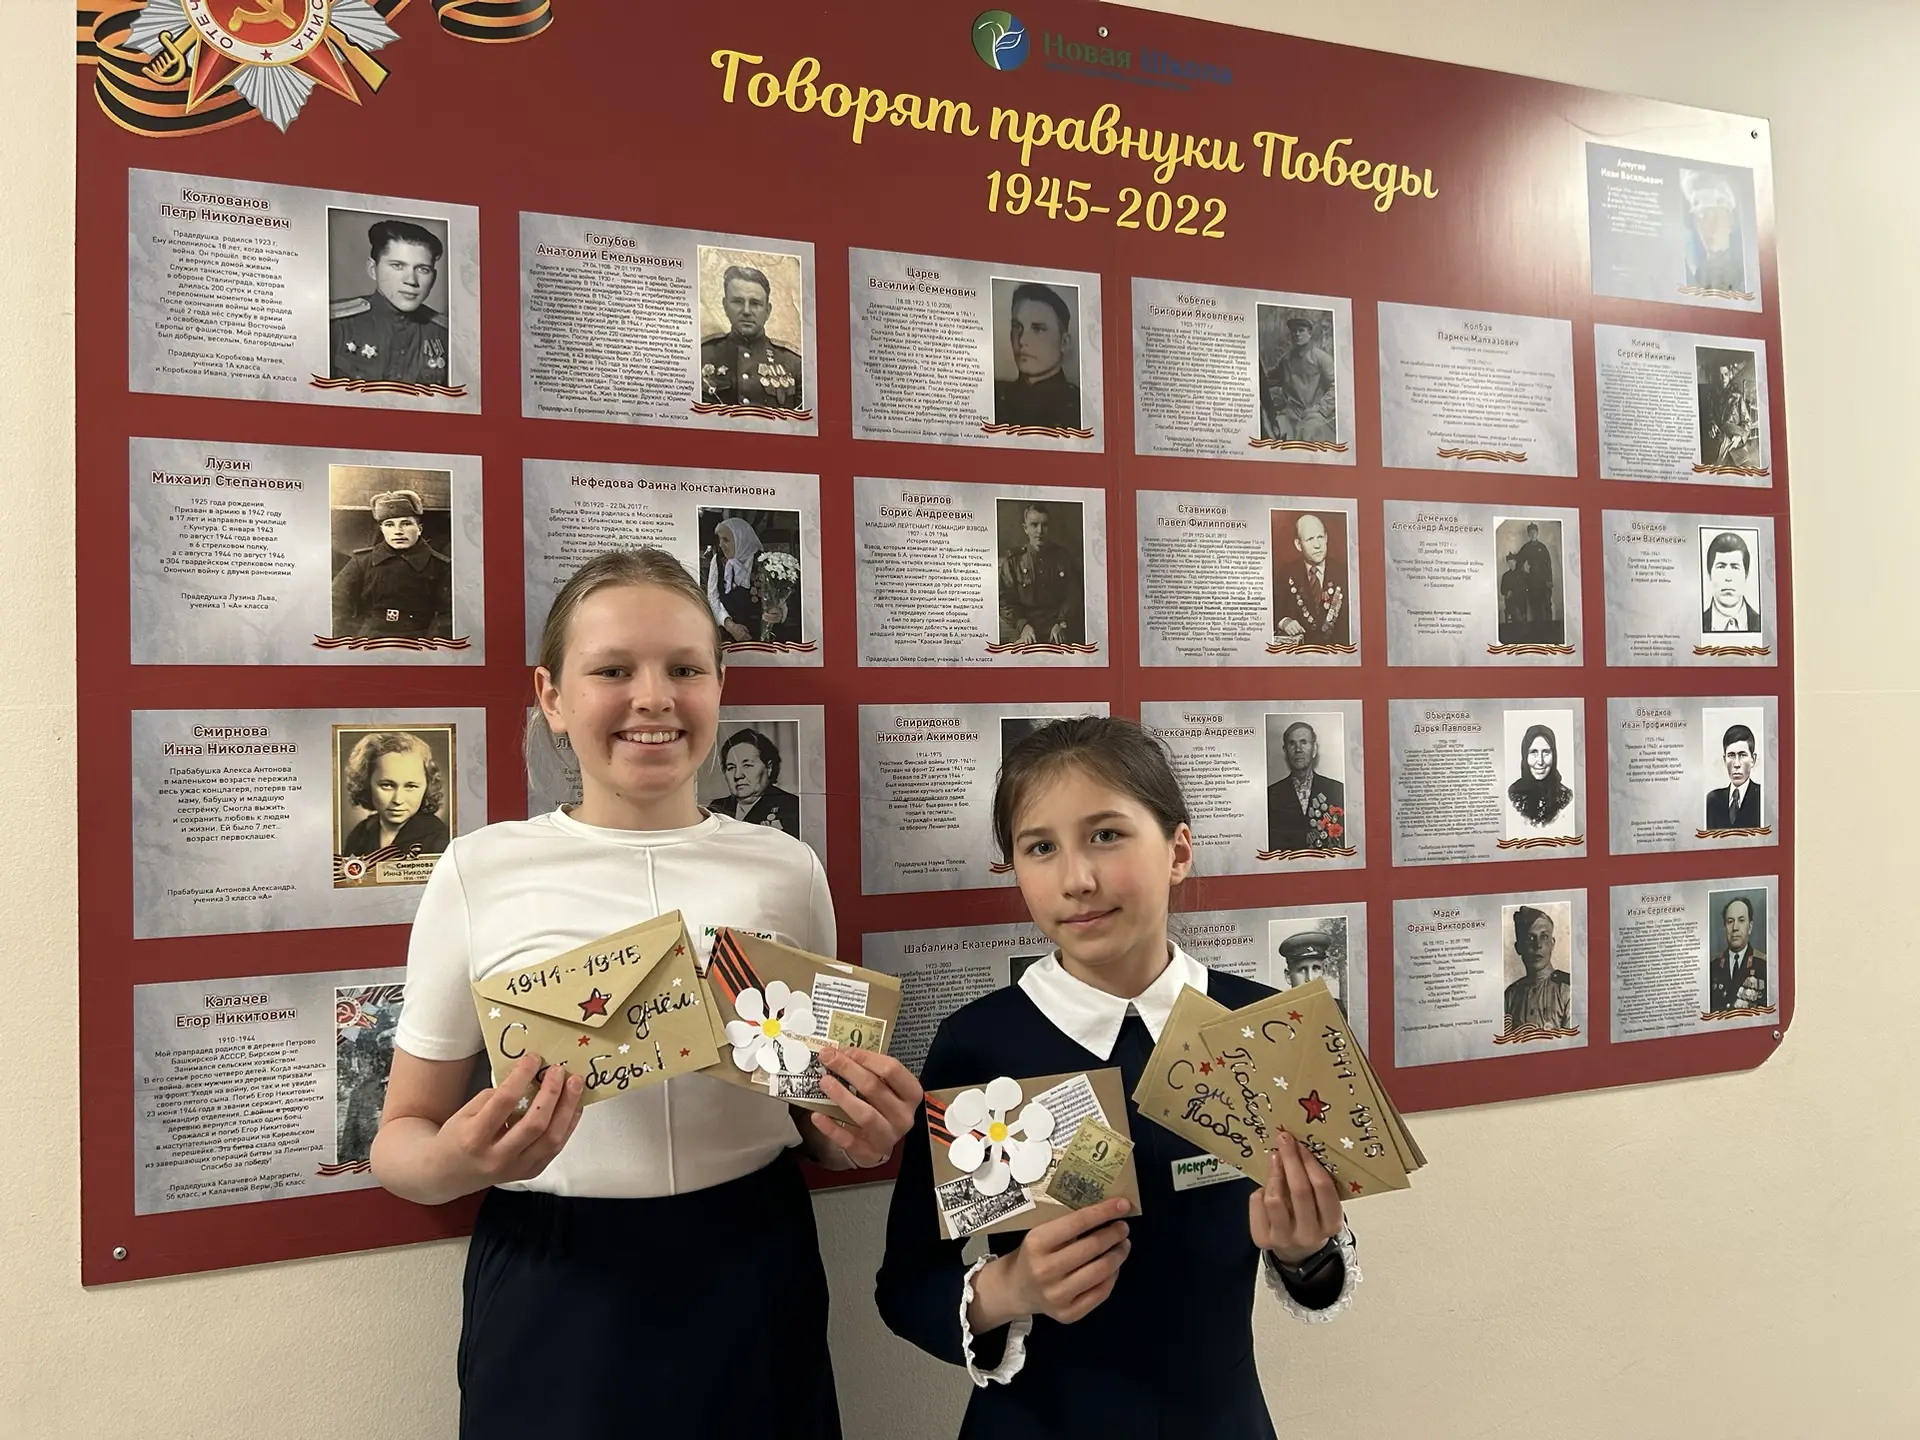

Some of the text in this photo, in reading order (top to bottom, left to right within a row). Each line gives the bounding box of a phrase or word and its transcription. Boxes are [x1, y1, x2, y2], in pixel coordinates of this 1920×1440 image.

[291, 0, 324, 51] ОЙНА
[1043, 31, 1132, 69] Новая
[1140, 47, 1234, 85] Школа
[990, 103, 1245, 184] правнуки
[1252, 131, 1439, 212] Победы
[183, 190, 268, 209] Котлованов
[986, 170, 1228, 239] 1945-2022
[162, 205, 289, 228] Петр Николаевич
[586, 233, 636, 247] Голубов
[536, 244, 682, 268] Анатолий Емельянович
[907, 267, 939, 280] Царев
[868, 278, 976, 297] Василий Семенович
[1178, 295, 1216, 306] Кобелев
[1150, 305, 1244, 322] Григорий Яковлевич
[206, 457, 250, 471] Лузин
[153, 472, 302, 489] Михаил Степанович
[572, 476, 775, 496] Нефедова Фаина Константиновна
[902, 493, 951, 505] Гаврилов
[881, 507, 973, 520] Борис Андреевич
[1178, 504, 1226, 514] Ставников
[1158, 517, 1247, 528] Павел Филиппович
[197, 567, 220, 576] войну
[181, 592, 228, 601] Прадедушка
[228, 593, 256, 601] Лузина
[896, 718, 960, 729] Спиридонов
[1184, 714, 1222, 724] Чикунов
[194, 726, 267, 739] Смирнова
[876, 732, 978, 743] Николай Акимович
[1150, 728, 1254, 740] Александр Андреевич
[164, 743, 296, 756] Инна Николаевна
[170, 767, 221, 776] Прабабушка
[904, 943, 958, 954] Шабалина
[962, 939, 1016, 950] Екатерина
[1188, 936, 1253, 947] Никифорович
[206, 994, 267, 1008] Калачев
[177, 1010, 295, 1028] Егор Никитович
[500, 991, 700, 1059] С днём
[1262, 1020, 1297, 1043] С
[1168, 1060, 1195, 1090] С
[1092, 1140, 1109, 1162] 9
